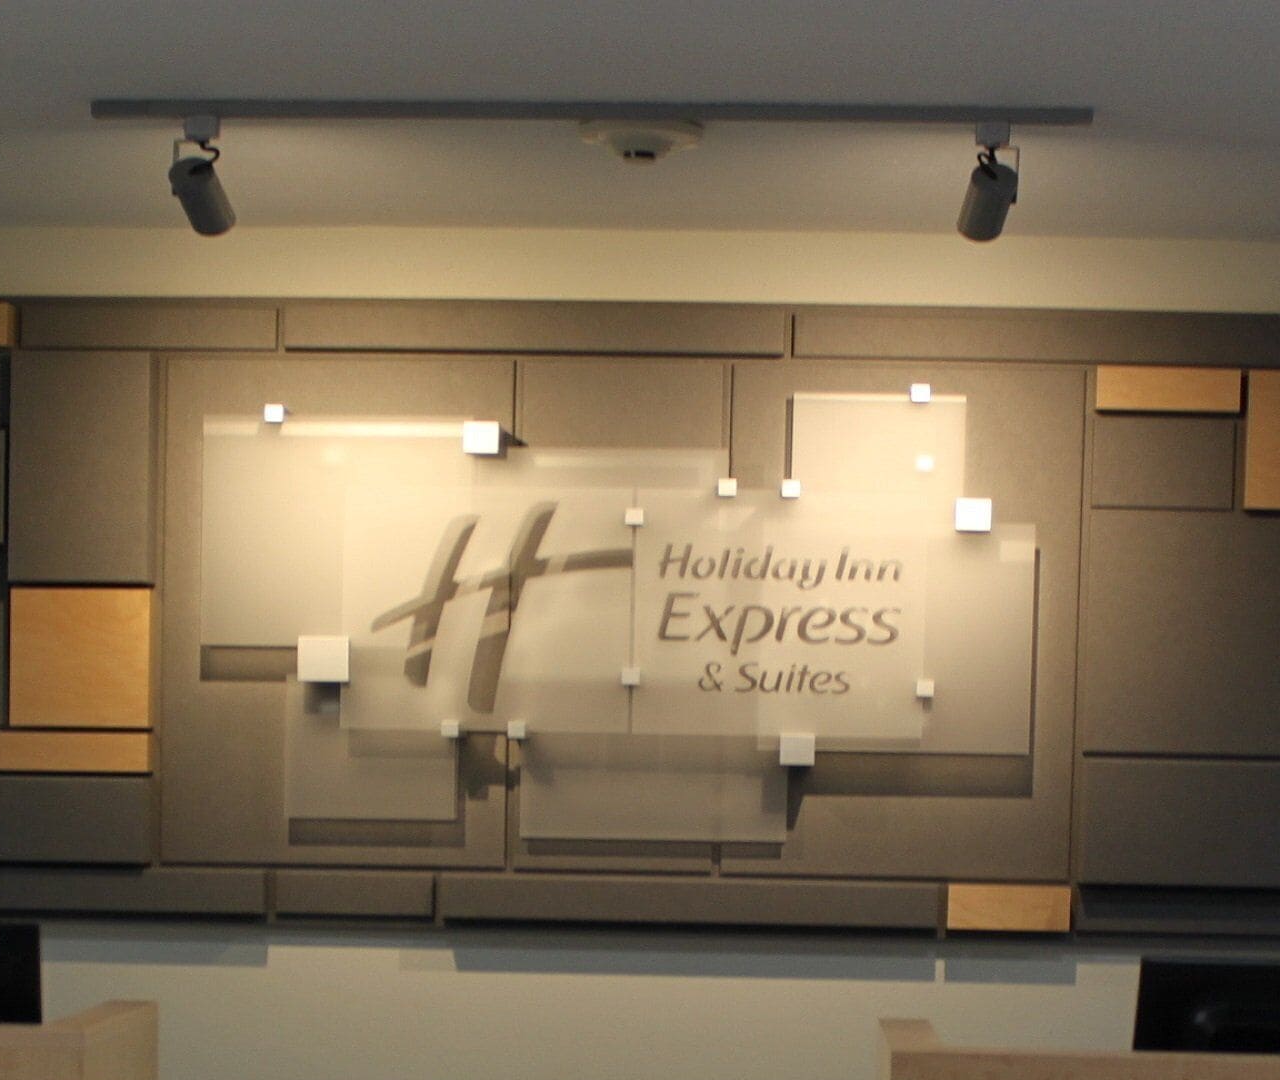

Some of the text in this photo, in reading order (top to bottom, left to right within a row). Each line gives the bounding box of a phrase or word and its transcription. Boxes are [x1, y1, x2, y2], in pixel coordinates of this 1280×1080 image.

[659, 543, 903, 590] Holiday Inn
[658, 592, 902, 656] Express
[698, 661, 851, 695] & Suites
